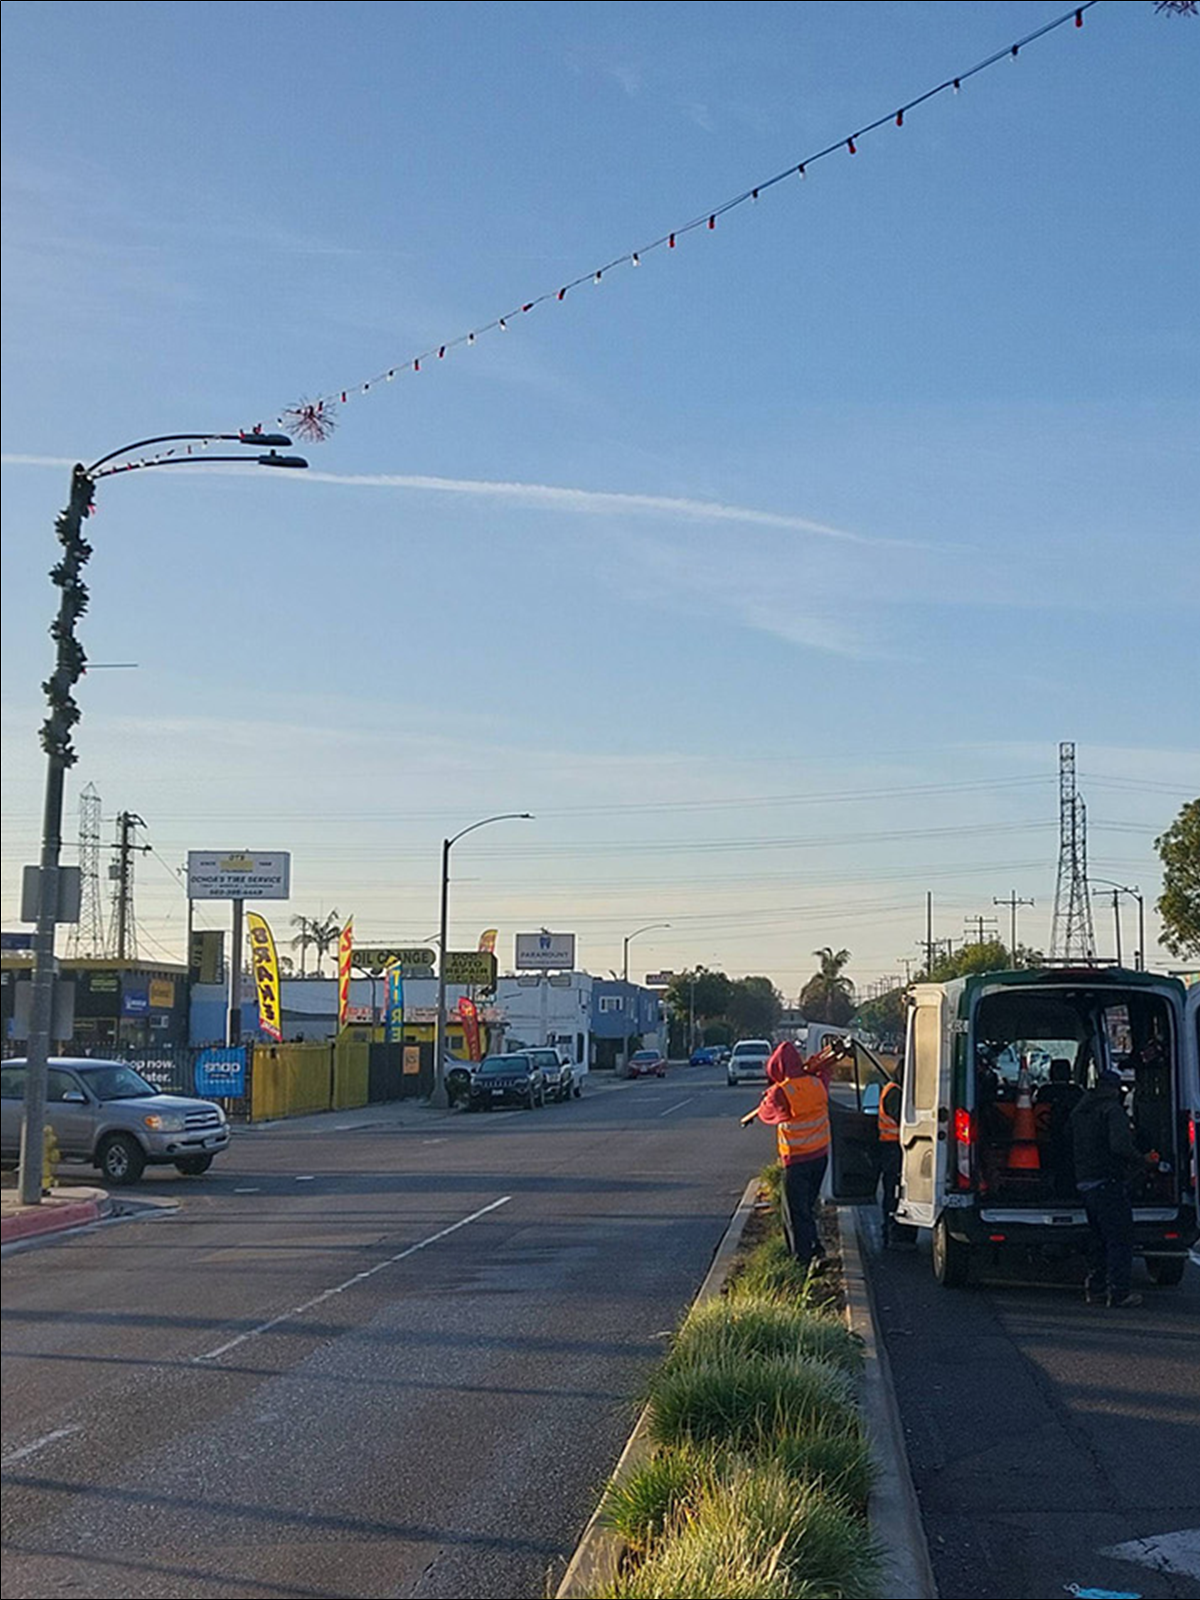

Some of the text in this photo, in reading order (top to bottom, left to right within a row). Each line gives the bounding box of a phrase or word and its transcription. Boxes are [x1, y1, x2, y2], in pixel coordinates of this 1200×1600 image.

[353, 952, 373, 964] OIL
[520, 951, 569, 959] PARAMOUNT
[451, 960, 483, 968] AUTO
[146, 1060, 176, 1069] now.
